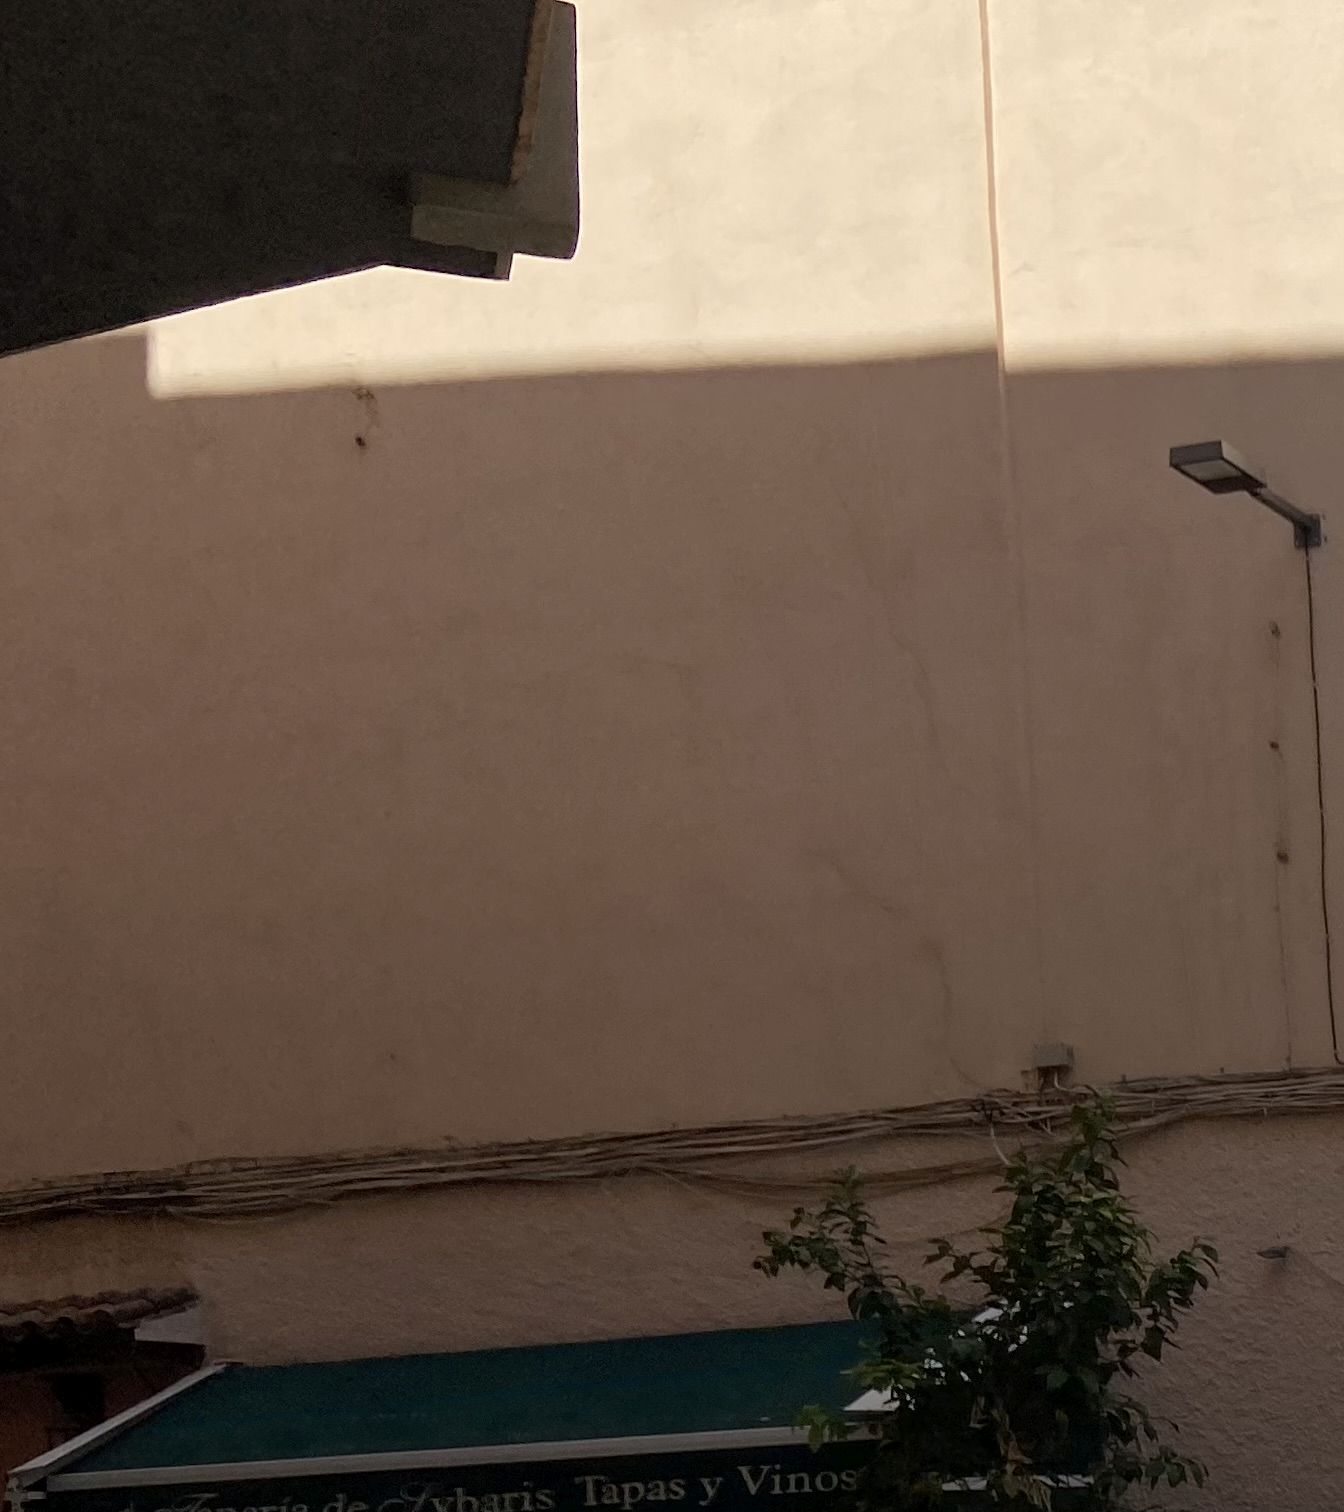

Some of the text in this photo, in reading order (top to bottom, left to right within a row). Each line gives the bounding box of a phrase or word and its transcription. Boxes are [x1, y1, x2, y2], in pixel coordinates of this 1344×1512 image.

[575, 1474, 688, 1510] Tapas
[699, 1476, 723, 1506] y
[737, 1463, 859, 1497] Vinos
